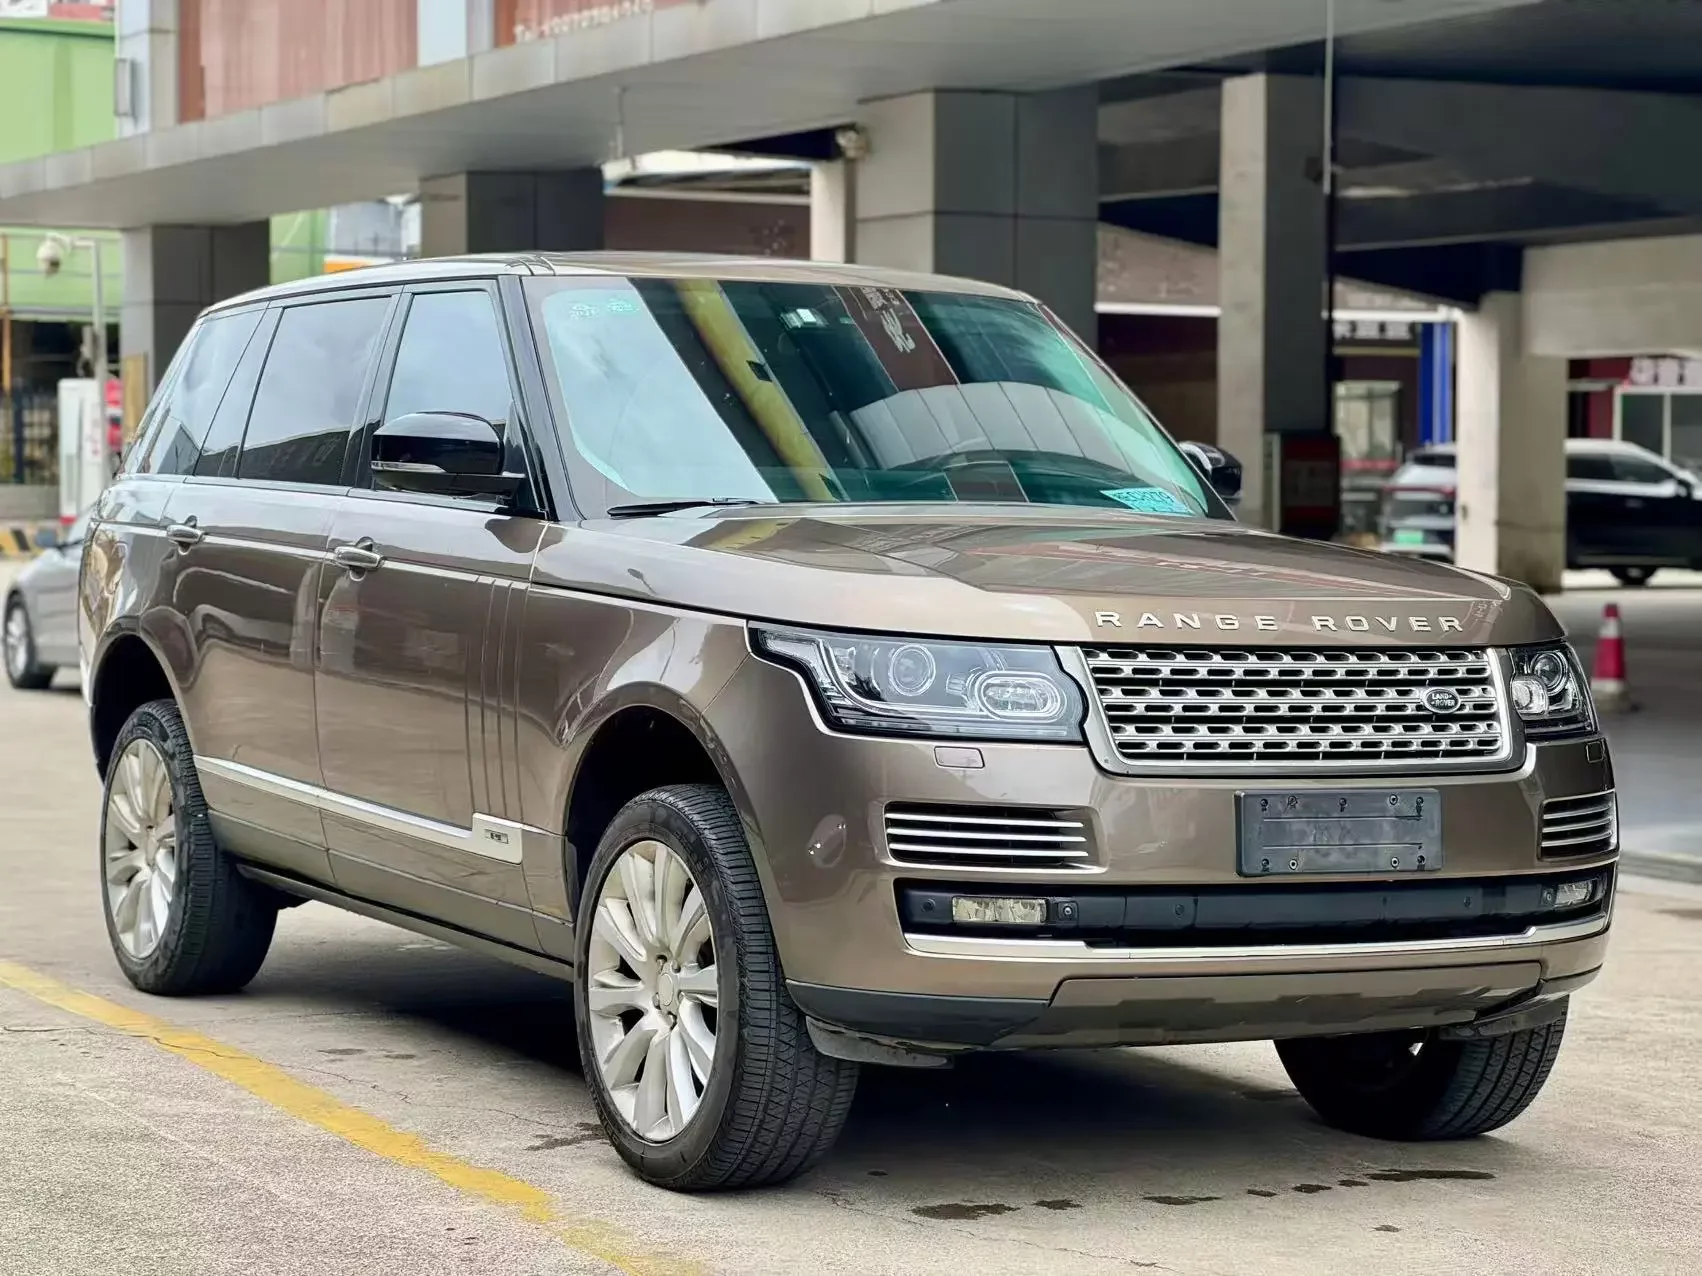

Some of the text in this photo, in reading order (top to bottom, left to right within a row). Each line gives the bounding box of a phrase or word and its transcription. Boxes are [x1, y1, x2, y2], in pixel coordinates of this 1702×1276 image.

[1095, 611, 1463, 632] RANGE ROVER
[1435, 699, 1456, 707] ROVER
